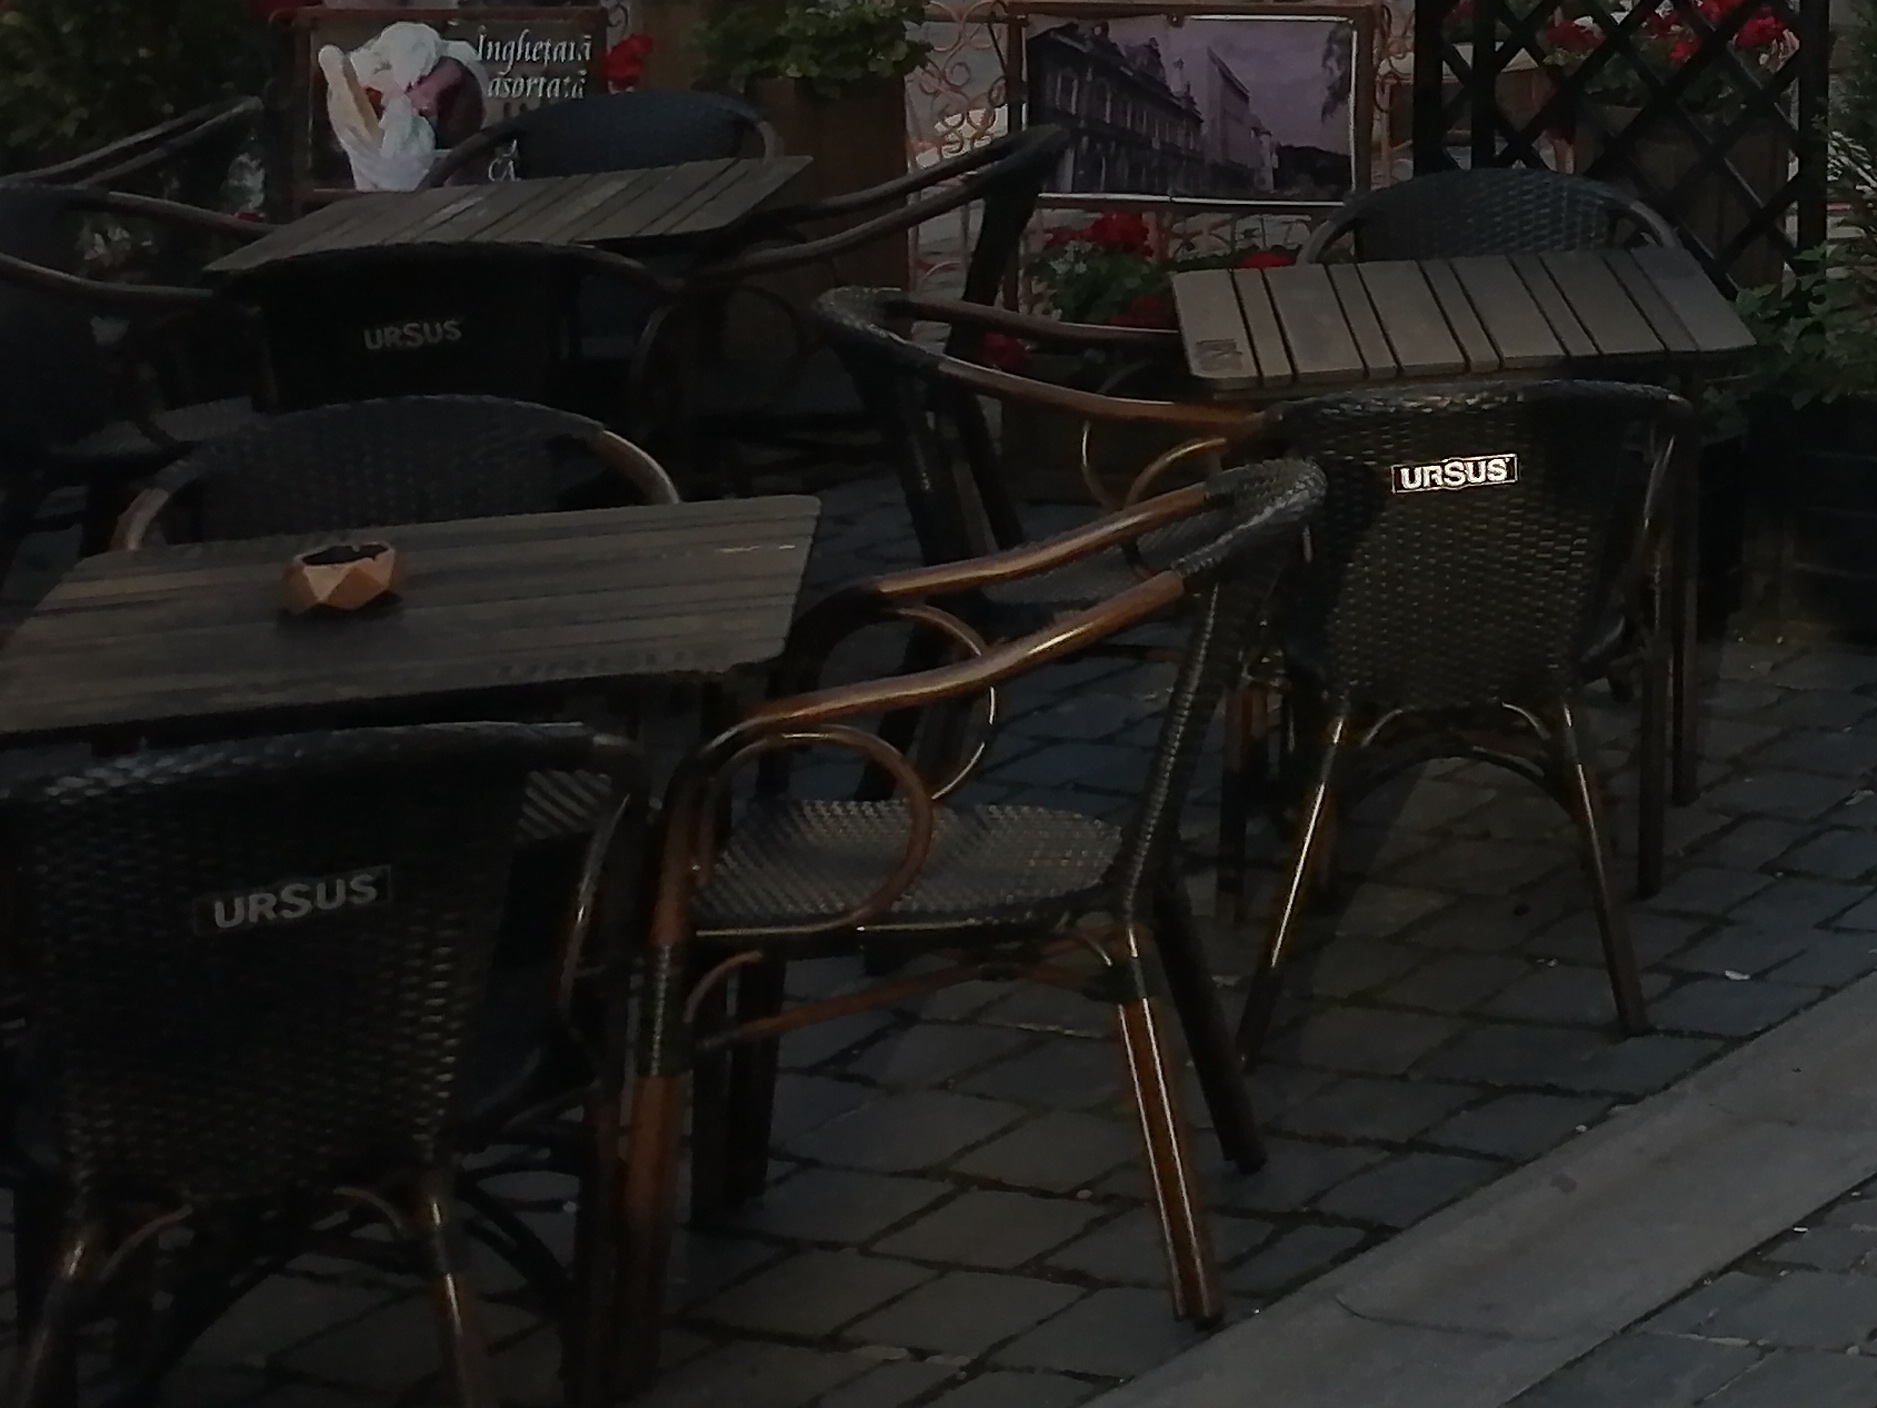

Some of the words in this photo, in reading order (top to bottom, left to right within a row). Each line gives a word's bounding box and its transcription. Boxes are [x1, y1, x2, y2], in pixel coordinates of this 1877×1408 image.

[363, 320, 462, 350] URSUS
[1400, 458, 1508, 489] URSUS
[214, 873, 377, 929] URSUS
